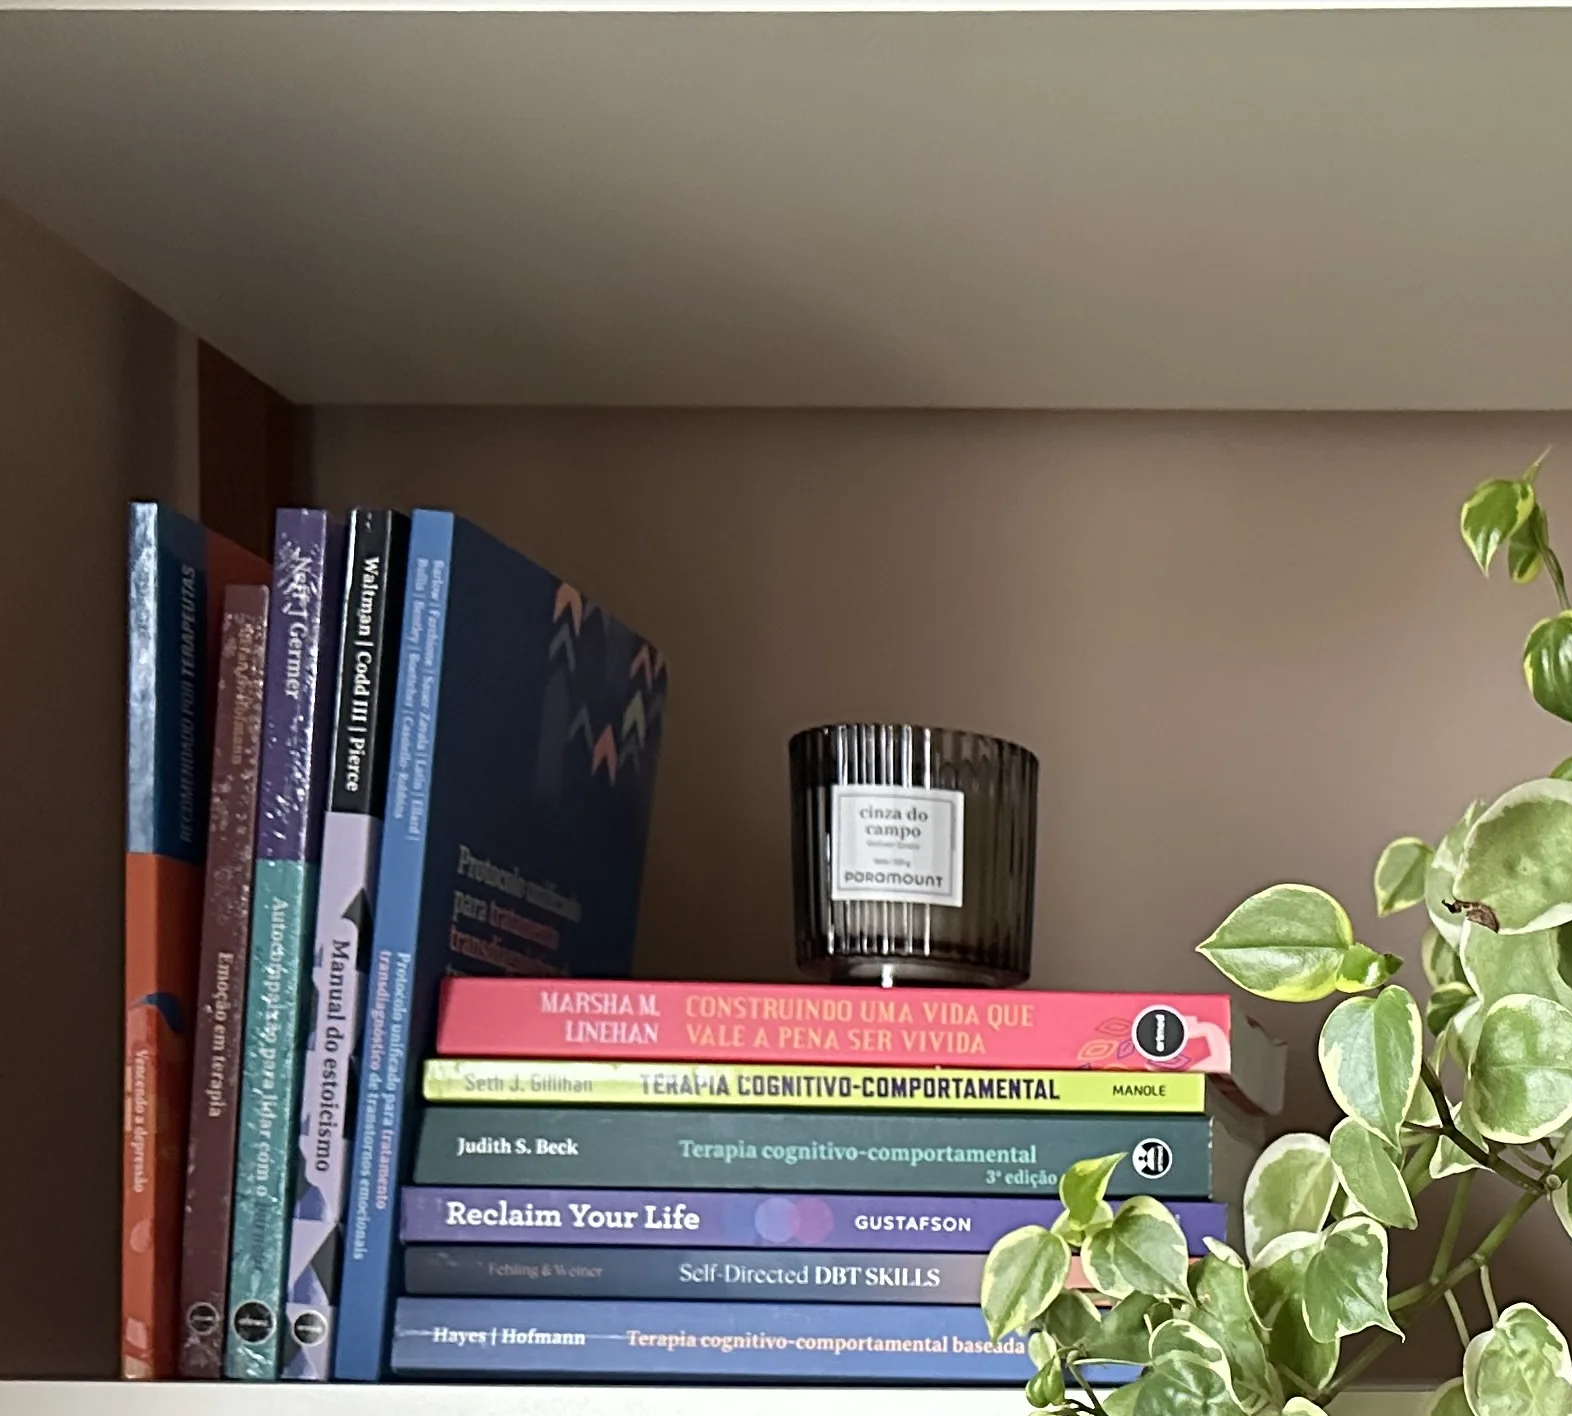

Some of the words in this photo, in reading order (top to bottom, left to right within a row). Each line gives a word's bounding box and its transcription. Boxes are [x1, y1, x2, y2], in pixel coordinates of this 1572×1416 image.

[357, 557, 380, 636] Waltman
[181, 564, 197, 677] TERAPEUTAS
[284, 622, 308, 700] Germer
[353, 651, 372, 696] Codd
[859, 805, 903, 821] cinza
[907, 807, 929, 822] do
[865, 824, 922, 845] campo
[327, 940, 350, 1020] Manual
[540, 991, 635, 1016] MARSHA
[638, 995, 661, 1017] M.
[685, 995, 853, 1022] CONSTRUINDO
[859, 1000, 914, 1025] UMA
[923, 1002, 980, 1026] VIDA
[986, 1003, 1036, 1029] QUE
[211, 1026, 228, 1051] em
[564, 1021, 659, 1044] LINEHAN
[685, 1023, 747, 1048] VALE
[778, 1025, 841, 1050] PENA
[847, 1029, 893, 1052] SER
[899, 1030, 987, 1055] VIVIDA
[259, 1048, 276, 1089] para
[465, 1072, 504, 1092] Seth
[530, 1073, 594, 1094] Gillihan
[205, 1055, 229, 1118] terapia
[736, 1074, 1061, 1101] COGNITIVO-COMPORTAMENTAL
[1111, 1083, 1167, 1098] MANOLE
[316, 1058, 340, 1172] estoicismo
[382, 1095, 396, 1127] para
[360, 1093, 381, 1177] transtornos
[256, 1142, 270, 1181] com
[456, 1137, 512, 1157] Judith
[536, 1138, 579, 1156] Beck
[678, 1138, 757, 1164] Terapia
[761, 1141, 1037, 1168] cognitivo-comportamental
[375, 1129, 395, 1211] tratamento
[1004, 1168, 1058, 1188] edição
[352, 1178, 372, 1260] emocionais
[445, 1199, 563, 1228] Reclaim
[568, 1203, 638, 1230] Your
[644, 1203, 700, 1231] Life
[854, 1214, 972, 1233] GUSTAFSON
[678, 1262, 809, 1286] Self-Directed
[865, 1267, 941, 1289] SKILLS
[501, 1327, 587, 1347] Hofmann
[626, 1330, 698, 1351] Terapia
